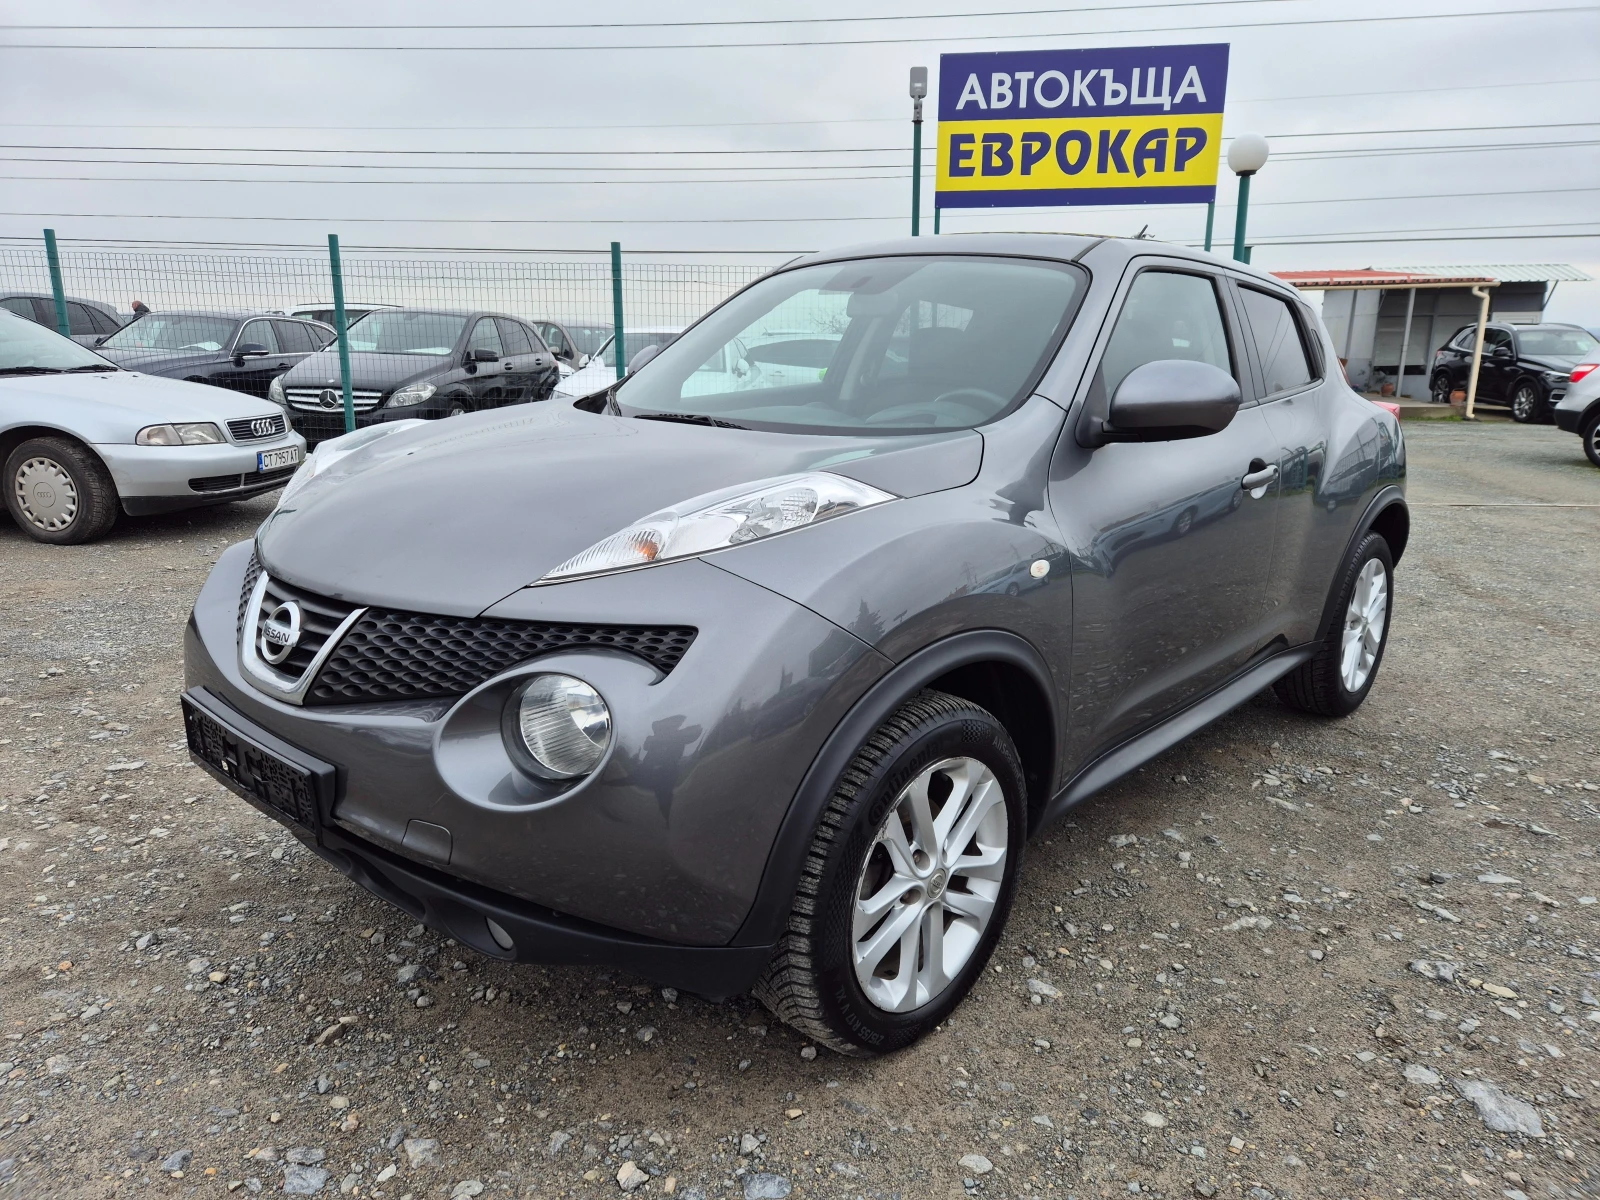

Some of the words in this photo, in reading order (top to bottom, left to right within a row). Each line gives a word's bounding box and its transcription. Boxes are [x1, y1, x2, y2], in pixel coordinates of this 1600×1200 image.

[955, 65, 1207, 111] АВТОКЪЩА
[948, 127, 1207, 179] ЕВРОКАР
[264, 626, 290, 642] SSAN
